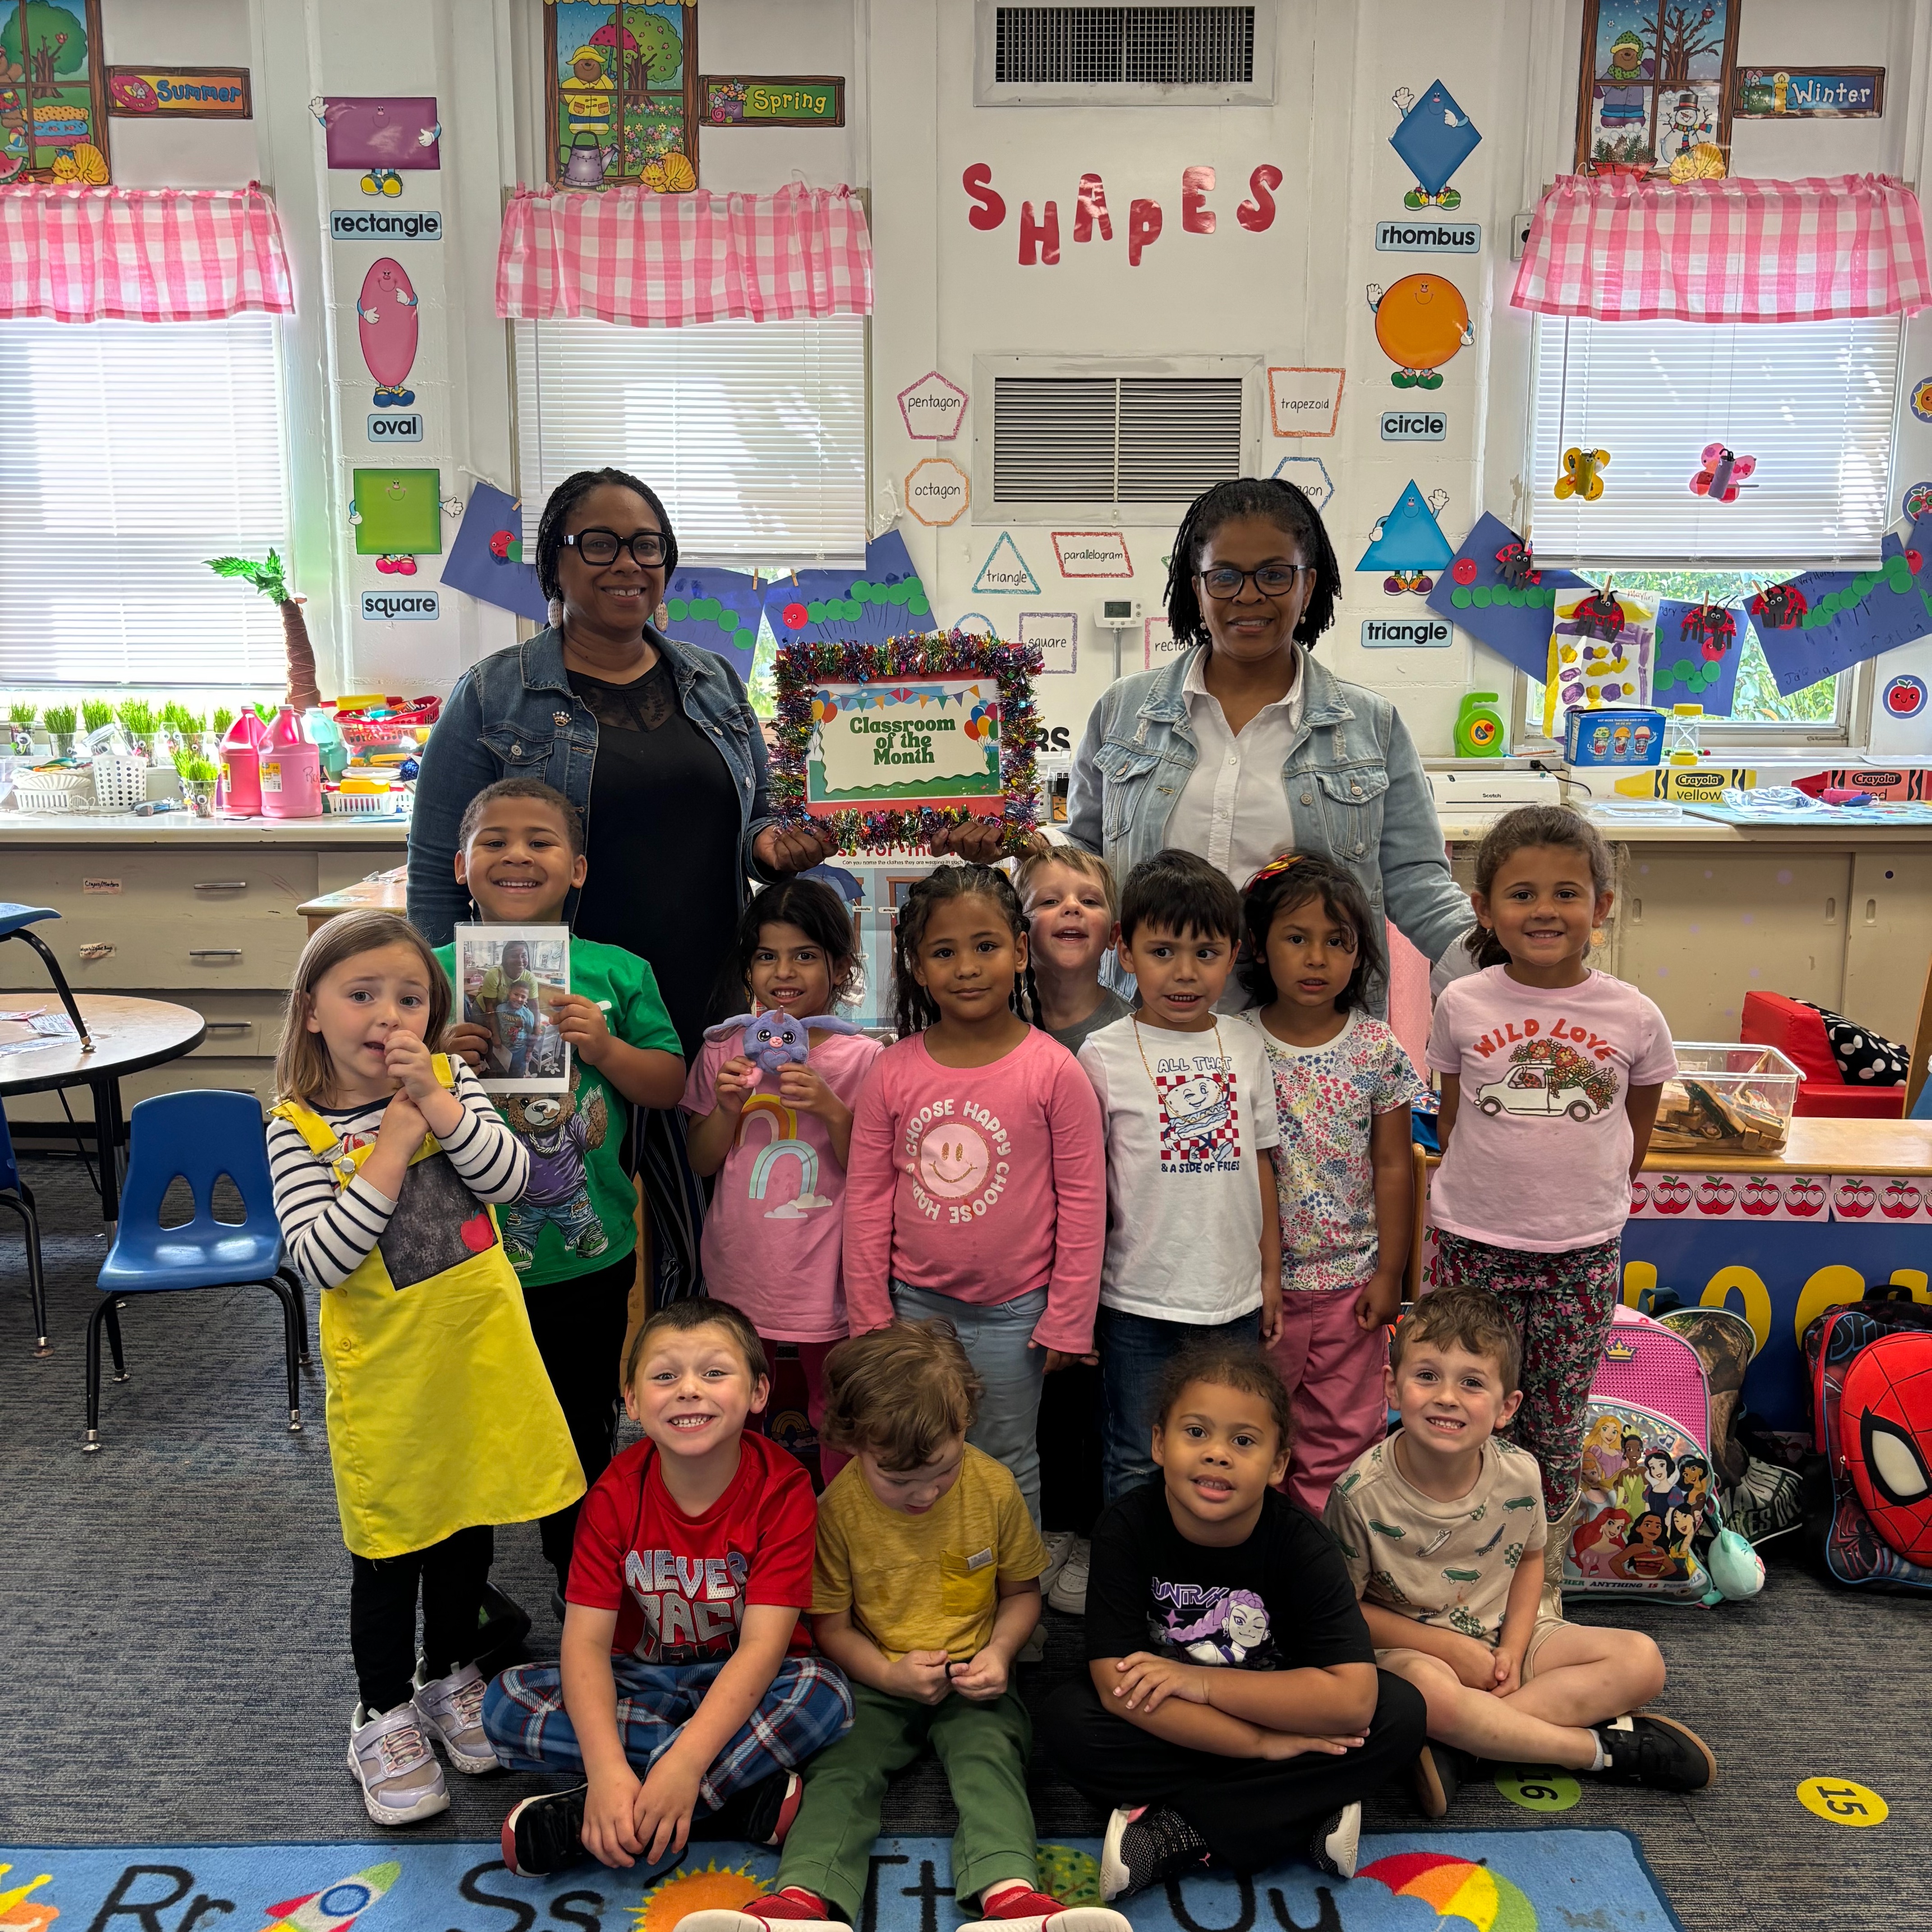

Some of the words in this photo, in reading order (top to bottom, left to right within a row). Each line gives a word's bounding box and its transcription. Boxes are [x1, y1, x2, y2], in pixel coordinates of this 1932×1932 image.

[156, 79, 242, 103] Summer
[1790, 79, 1871, 104] Winter
[753, 90, 827, 114] Spring
[962, 162, 1283, 267] SHAPES
[334, 214, 438, 238] rectangle
[1381, 226, 1475, 246] rhombus
[908, 394, 961, 413] pentagon
[1281, 398, 1329, 414] trapezoid
[373, 417, 417, 436] oval
[1384, 415, 1443, 434] circle
[915, 483, 961, 499] octagon
[1063, 548, 1123, 564] parallelogram
[986, 570, 1027, 586] triangle
[364, 598, 436, 618] square
[1367, 622, 1448, 645] triangle
[1028, 637, 1067, 651] square
[850, 716, 956, 734] Classroom
[876, 732, 897, 749] of
[901, 731, 932, 748] the
[873, 747, 935, 765] Month
[1678, 774, 1719, 786] Crayola
[1854, 774, 1895, 785] Crayola
[1473, 1018, 1540, 1058] WILD
[1549, 1018, 1618, 1061] LOVE
[1158, 1058, 1190, 1073] ALL
[1192, 1056, 1232, 1072] THAT
[905, 1099, 955, 1157] CHOOSE
[963, 1100, 1011, 1156] HAPPY
[1161, 1164, 1168, 1173] &
[1170, 1164, 1177, 1173] A
[1178, 1163, 1202, 1173] SIDE
[1204, 1162, 1215, 1173] OF
[1218, 1161, 1240, 1171] FRIES
[949, 1162, 1010, 1224] CHOOSE
[625, 1550, 749, 1600] NEVER
[1515, 1769, 1558, 1802] 16
[1816, 1785, 1869, 1817] 15
